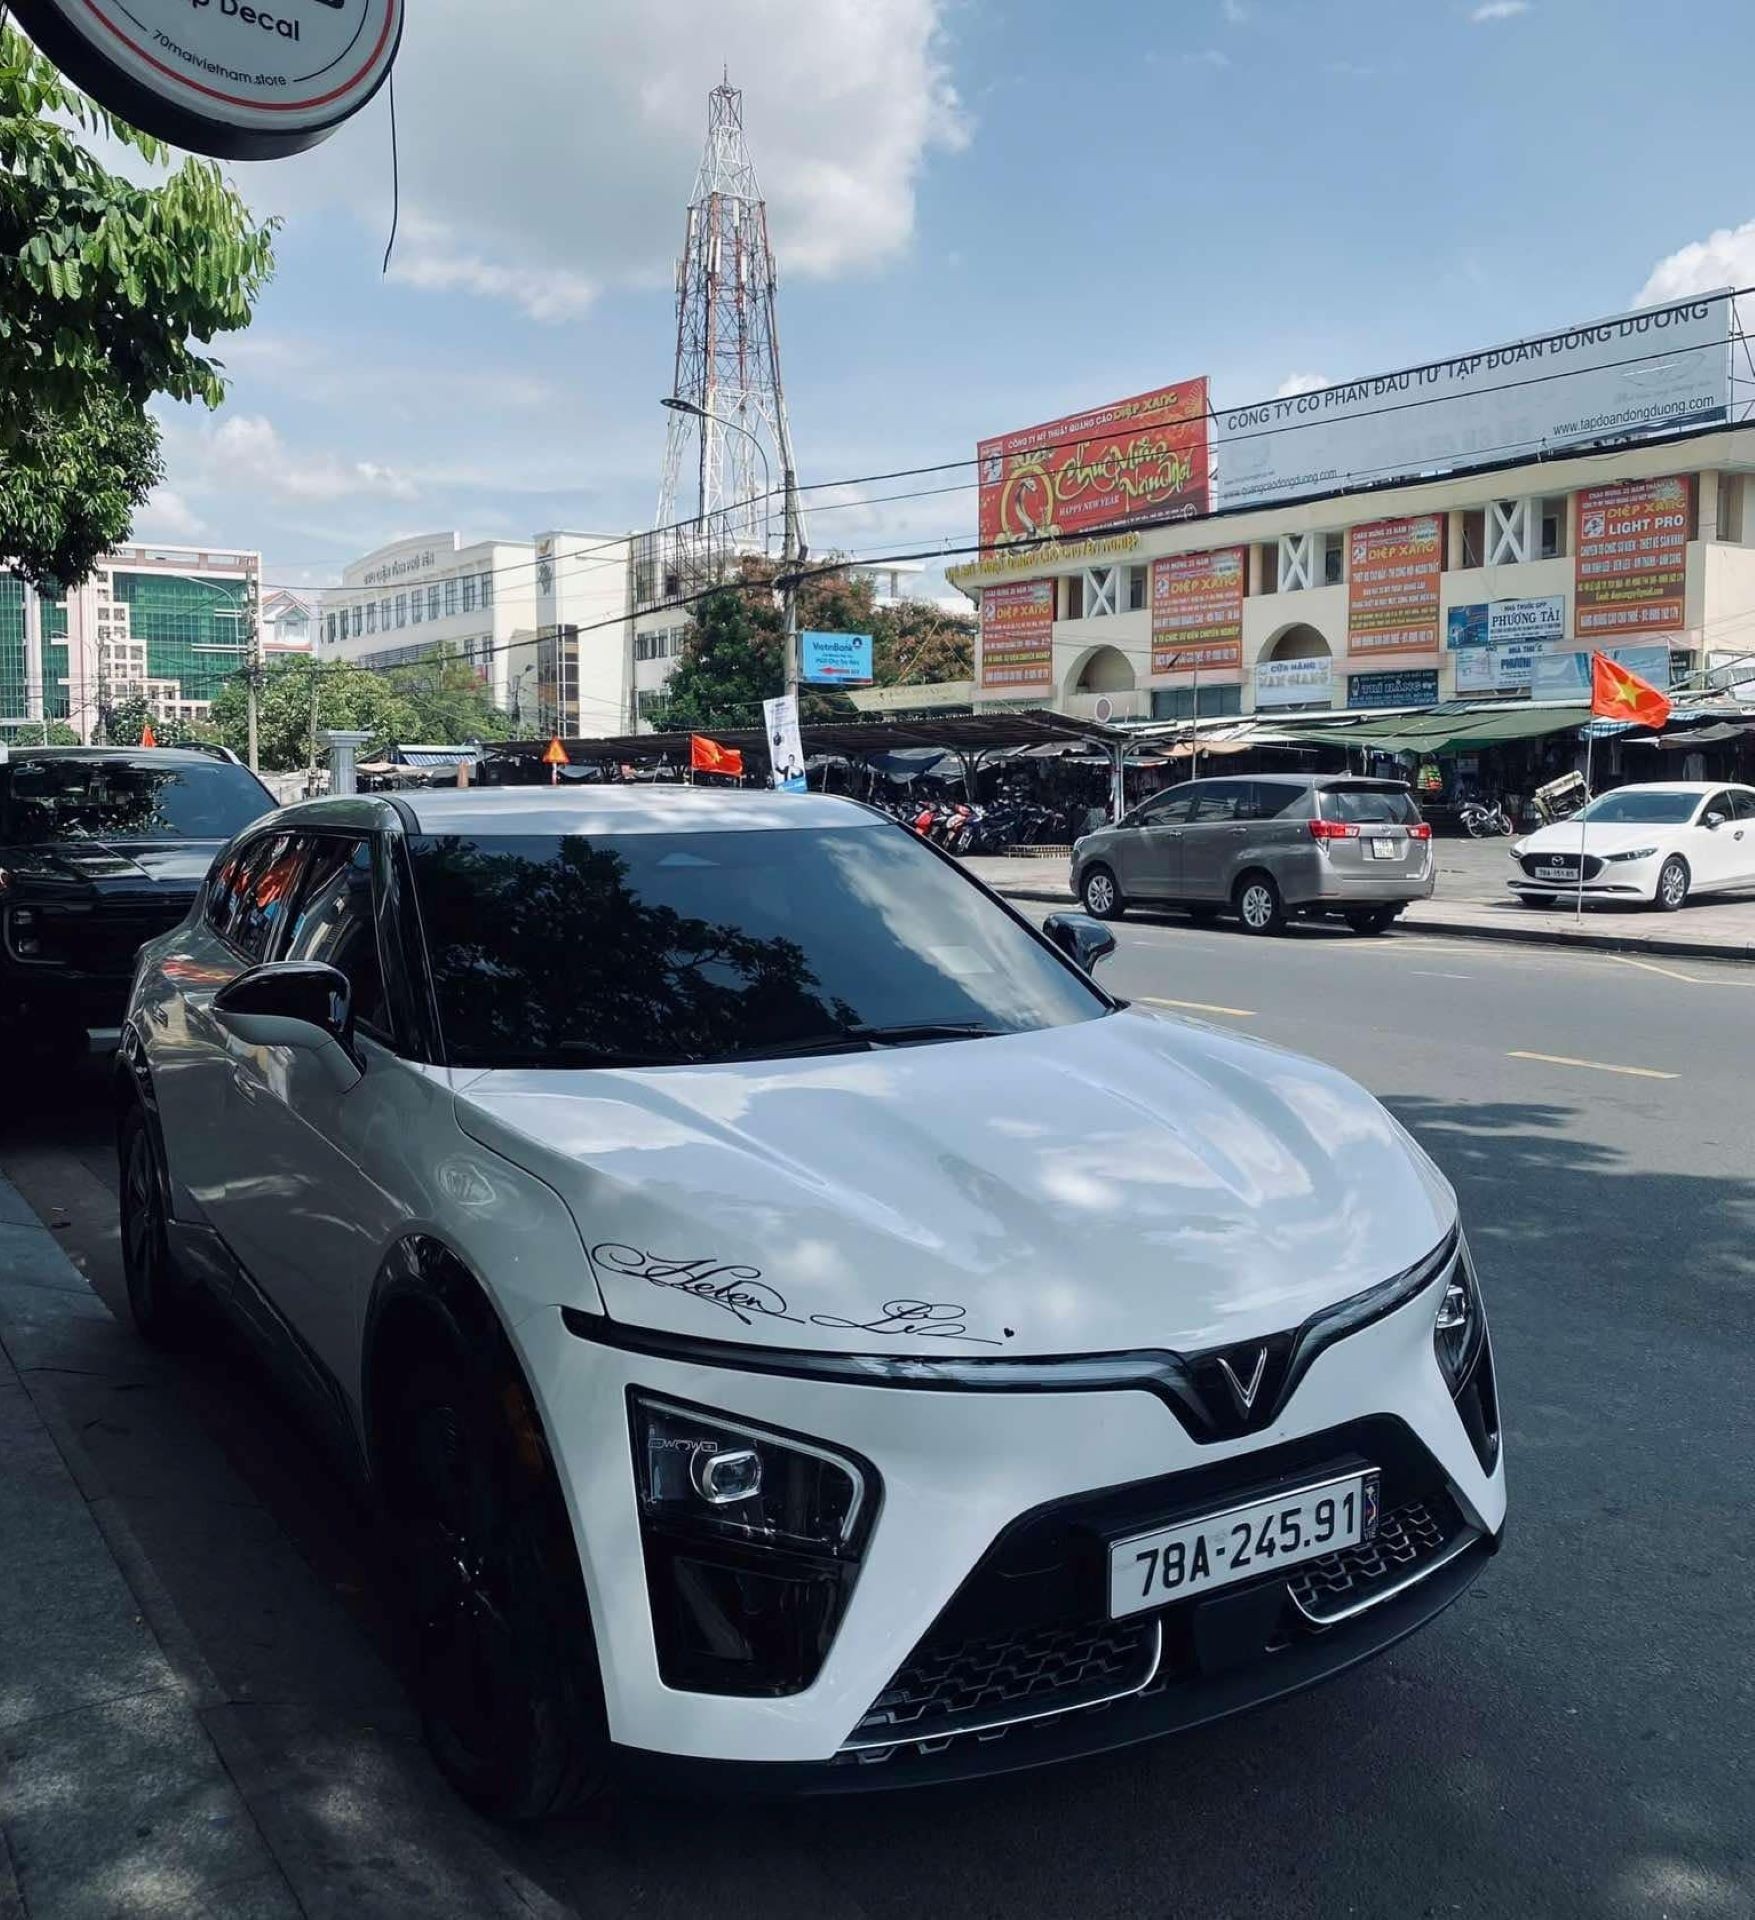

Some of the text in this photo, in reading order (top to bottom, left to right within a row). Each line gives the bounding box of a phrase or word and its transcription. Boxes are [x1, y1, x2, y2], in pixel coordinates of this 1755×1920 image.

[220, 0, 300, 41] Decal
[152, 29, 287, 86] 70maivietnam.store
[1274, 401, 1293, 419] TY
[1059, 494, 1120, 517] HAPPY NEW YEAR
[1609, 514, 1684, 535] LIGHT PRO
[590, 1241, 806, 1326] Helen
[1135, 1491, 1356, 1597] 78A-245.91
